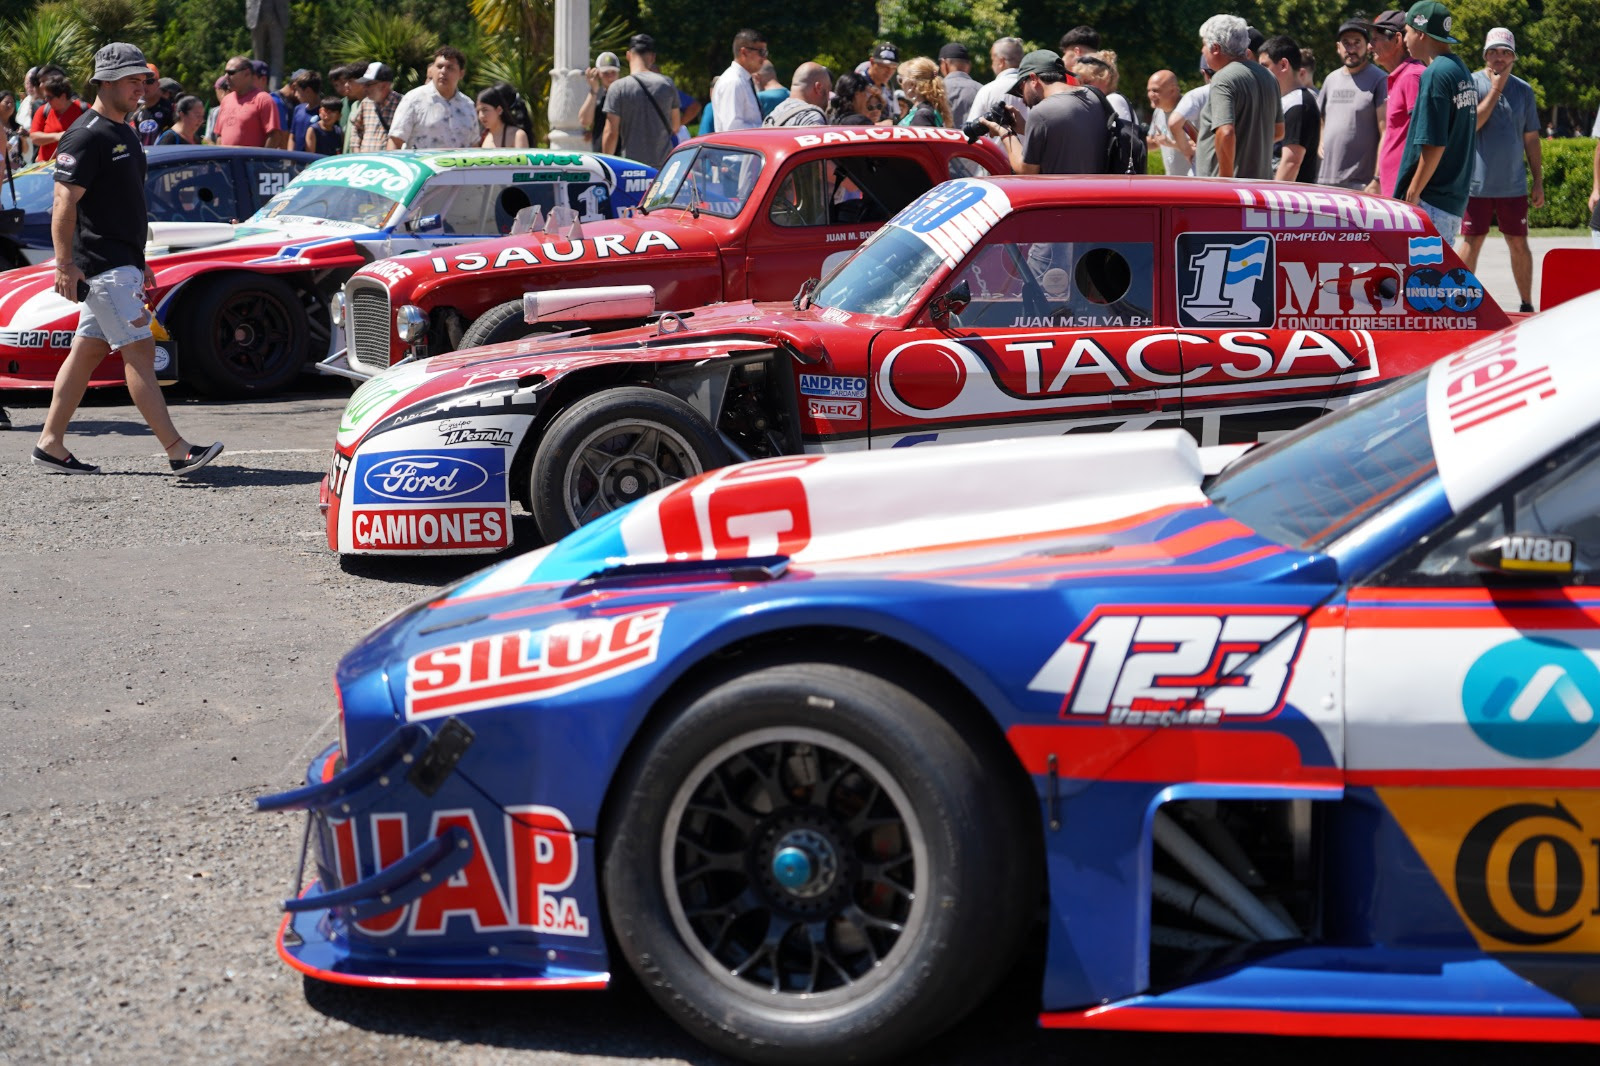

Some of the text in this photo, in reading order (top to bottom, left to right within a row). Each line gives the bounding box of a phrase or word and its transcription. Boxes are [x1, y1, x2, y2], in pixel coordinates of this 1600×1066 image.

[620, 170, 647, 178] JOSE
[1234, 188, 1424, 231] LIDERAR
[825, 232, 846, 243] JUAN
[848, 232, 858, 242] M.
[1275, 230, 1371, 243] CAMPEÓN 2005
[431, 230, 681, 273] ISAURA
[1009, 315, 1151, 328] JUAN M.SILVA B+
[19, 330, 48, 346] car
[1005, 330, 1356, 394] TACSA
[801, 376, 866, 391] ANDREO
[831, 390, 865, 398] CARDANES
[810, 402, 857, 417] SAENZ
[438, 418, 472, 433] Equipo
[373, 461, 460, 493] Ford
[355, 511, 503, 545] CAMIONES
[1502, 536, 1572, 562] W80
[1070, 614, 1304, 715] 123
[1455, 797, 1600, 946] Co
[542, 900, 586, 932] S.A.
